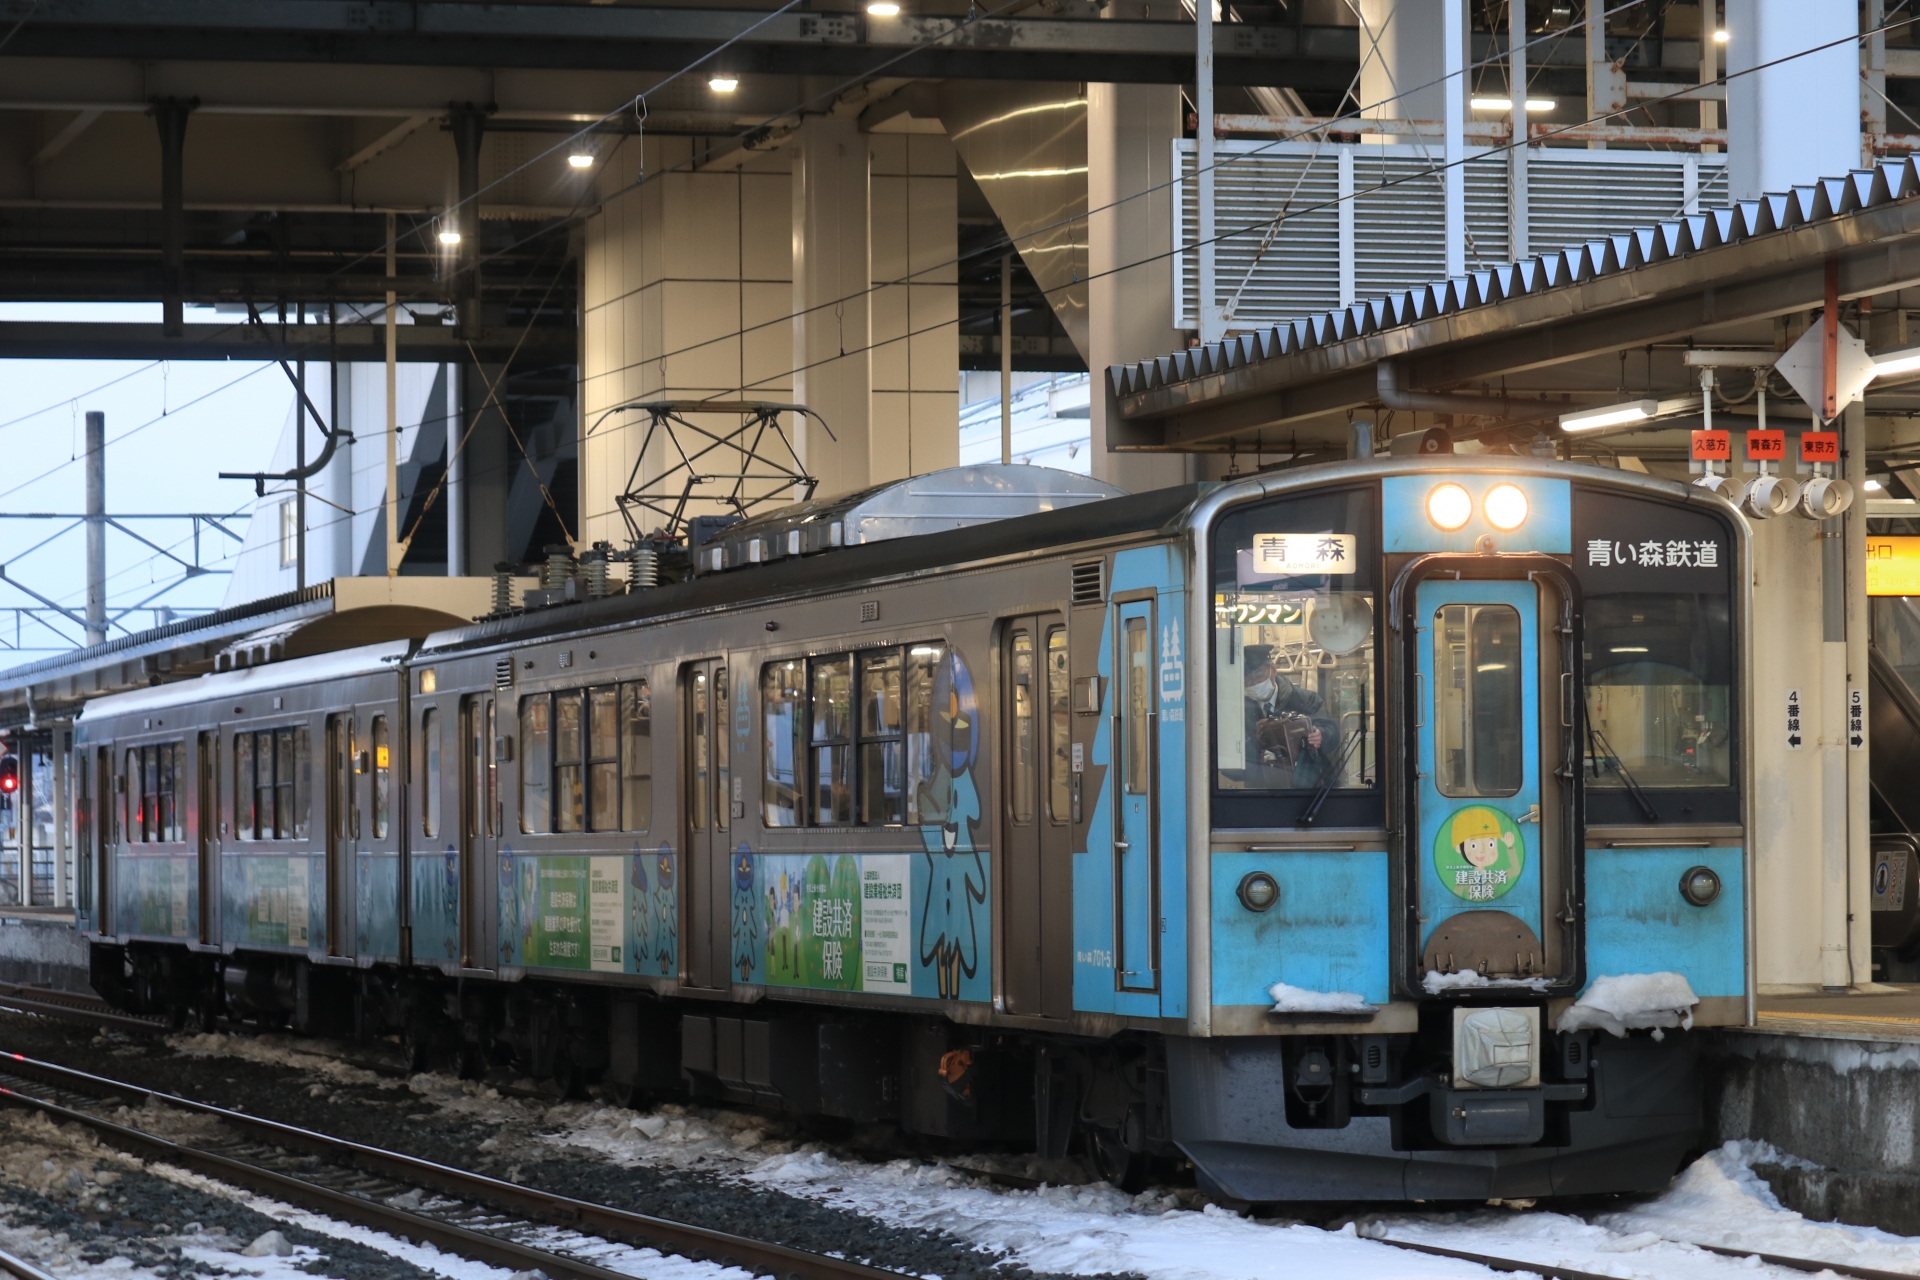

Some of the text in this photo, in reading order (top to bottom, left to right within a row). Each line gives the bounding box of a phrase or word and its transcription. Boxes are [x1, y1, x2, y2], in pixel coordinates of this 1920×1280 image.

[1695, 439, 1726, 452] 久慈方
[1750, 439, 1781, 451] 青森方
[1804, 441, 1835, 454] 東京方
[1260, 537, 1345, 561] 青森
[1587, 539, 1718, 567] 青い森鉄道
[1787, 691, 1800, 731] 4番線
[1850, 691, 1862, 732] 5番線
[1455, 870, 1507, 885] 建設共済
[1468, 885, 1495, 899] 保険
[812, 898, 853, 939] 建設共済
[822, 940, 843, 980] 保険
